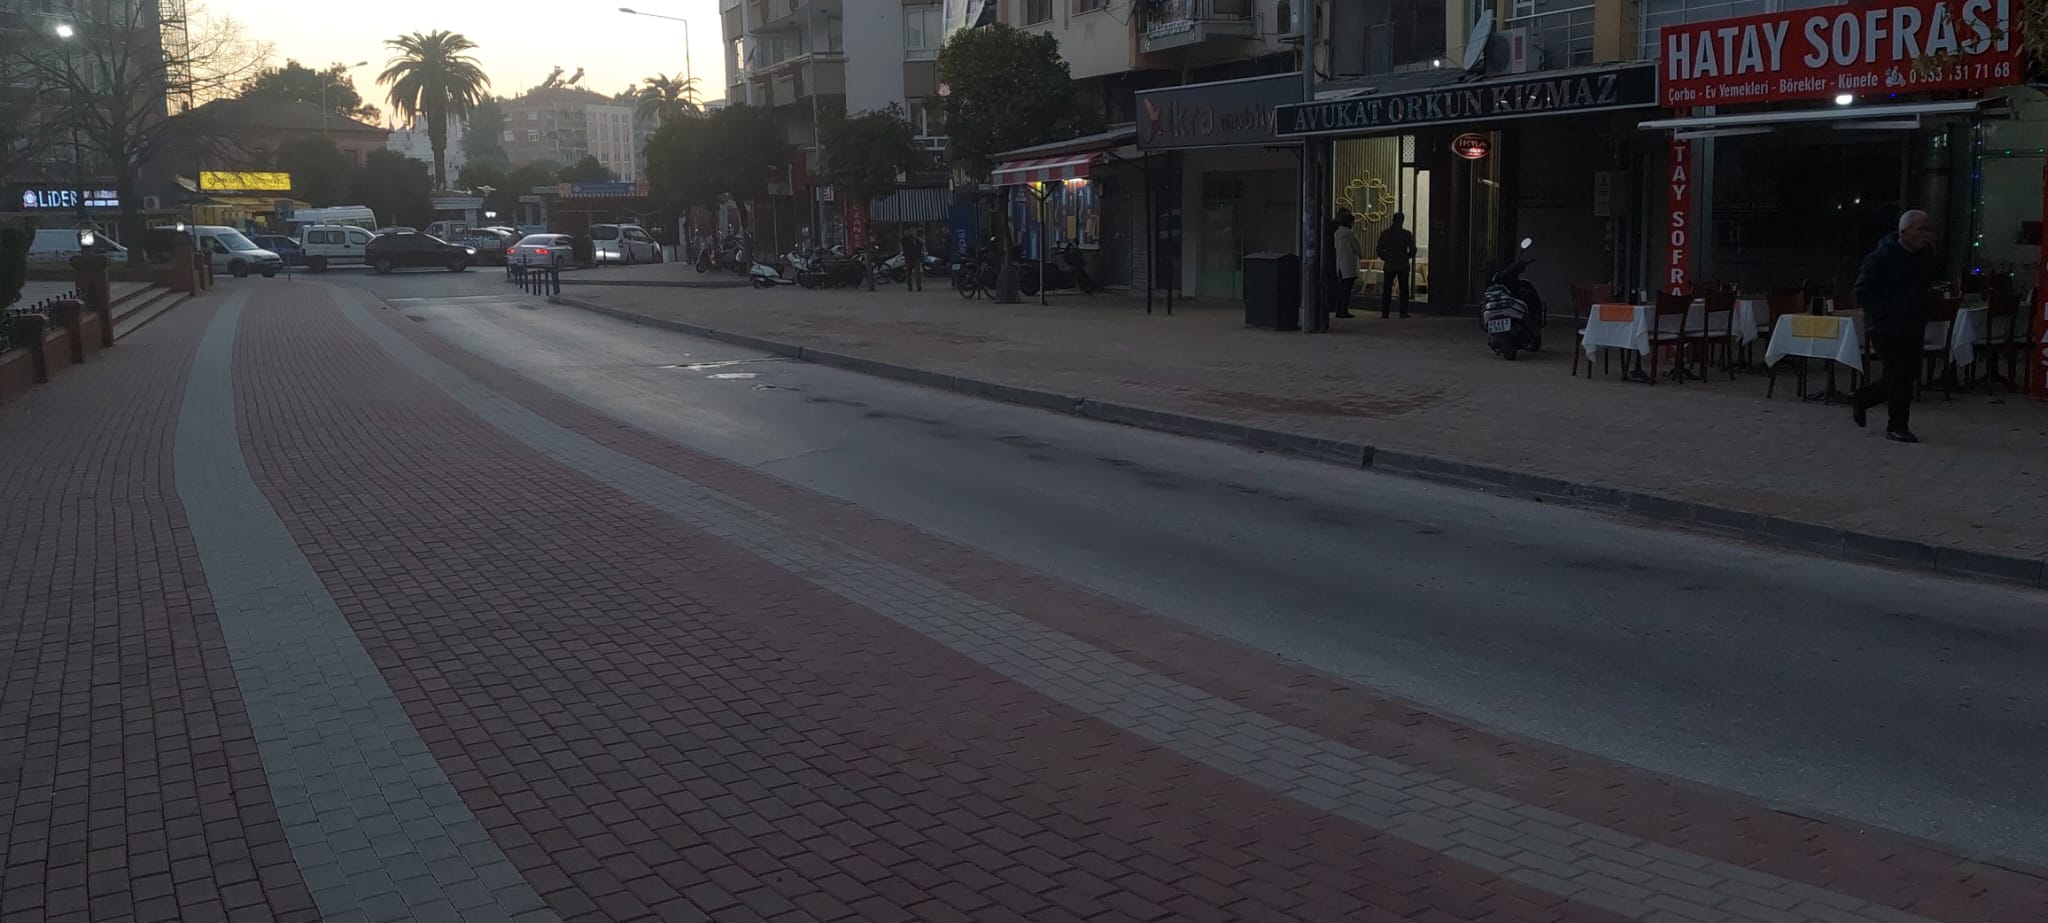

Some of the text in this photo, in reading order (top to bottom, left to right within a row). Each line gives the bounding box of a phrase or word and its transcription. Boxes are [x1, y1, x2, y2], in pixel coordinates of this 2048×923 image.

[1668, 0, 2010, 80] HATAY SOFRASI
[1668, 73, 1879, 103] Çorba Ev Yemekleri Börekler Künefe
[1975, 63, 1989, 80] 71
[1994, 61, 2010, 78] 68
[1294, 74, 1617, 132] AVUKAT ORKUN KIZMAZ
